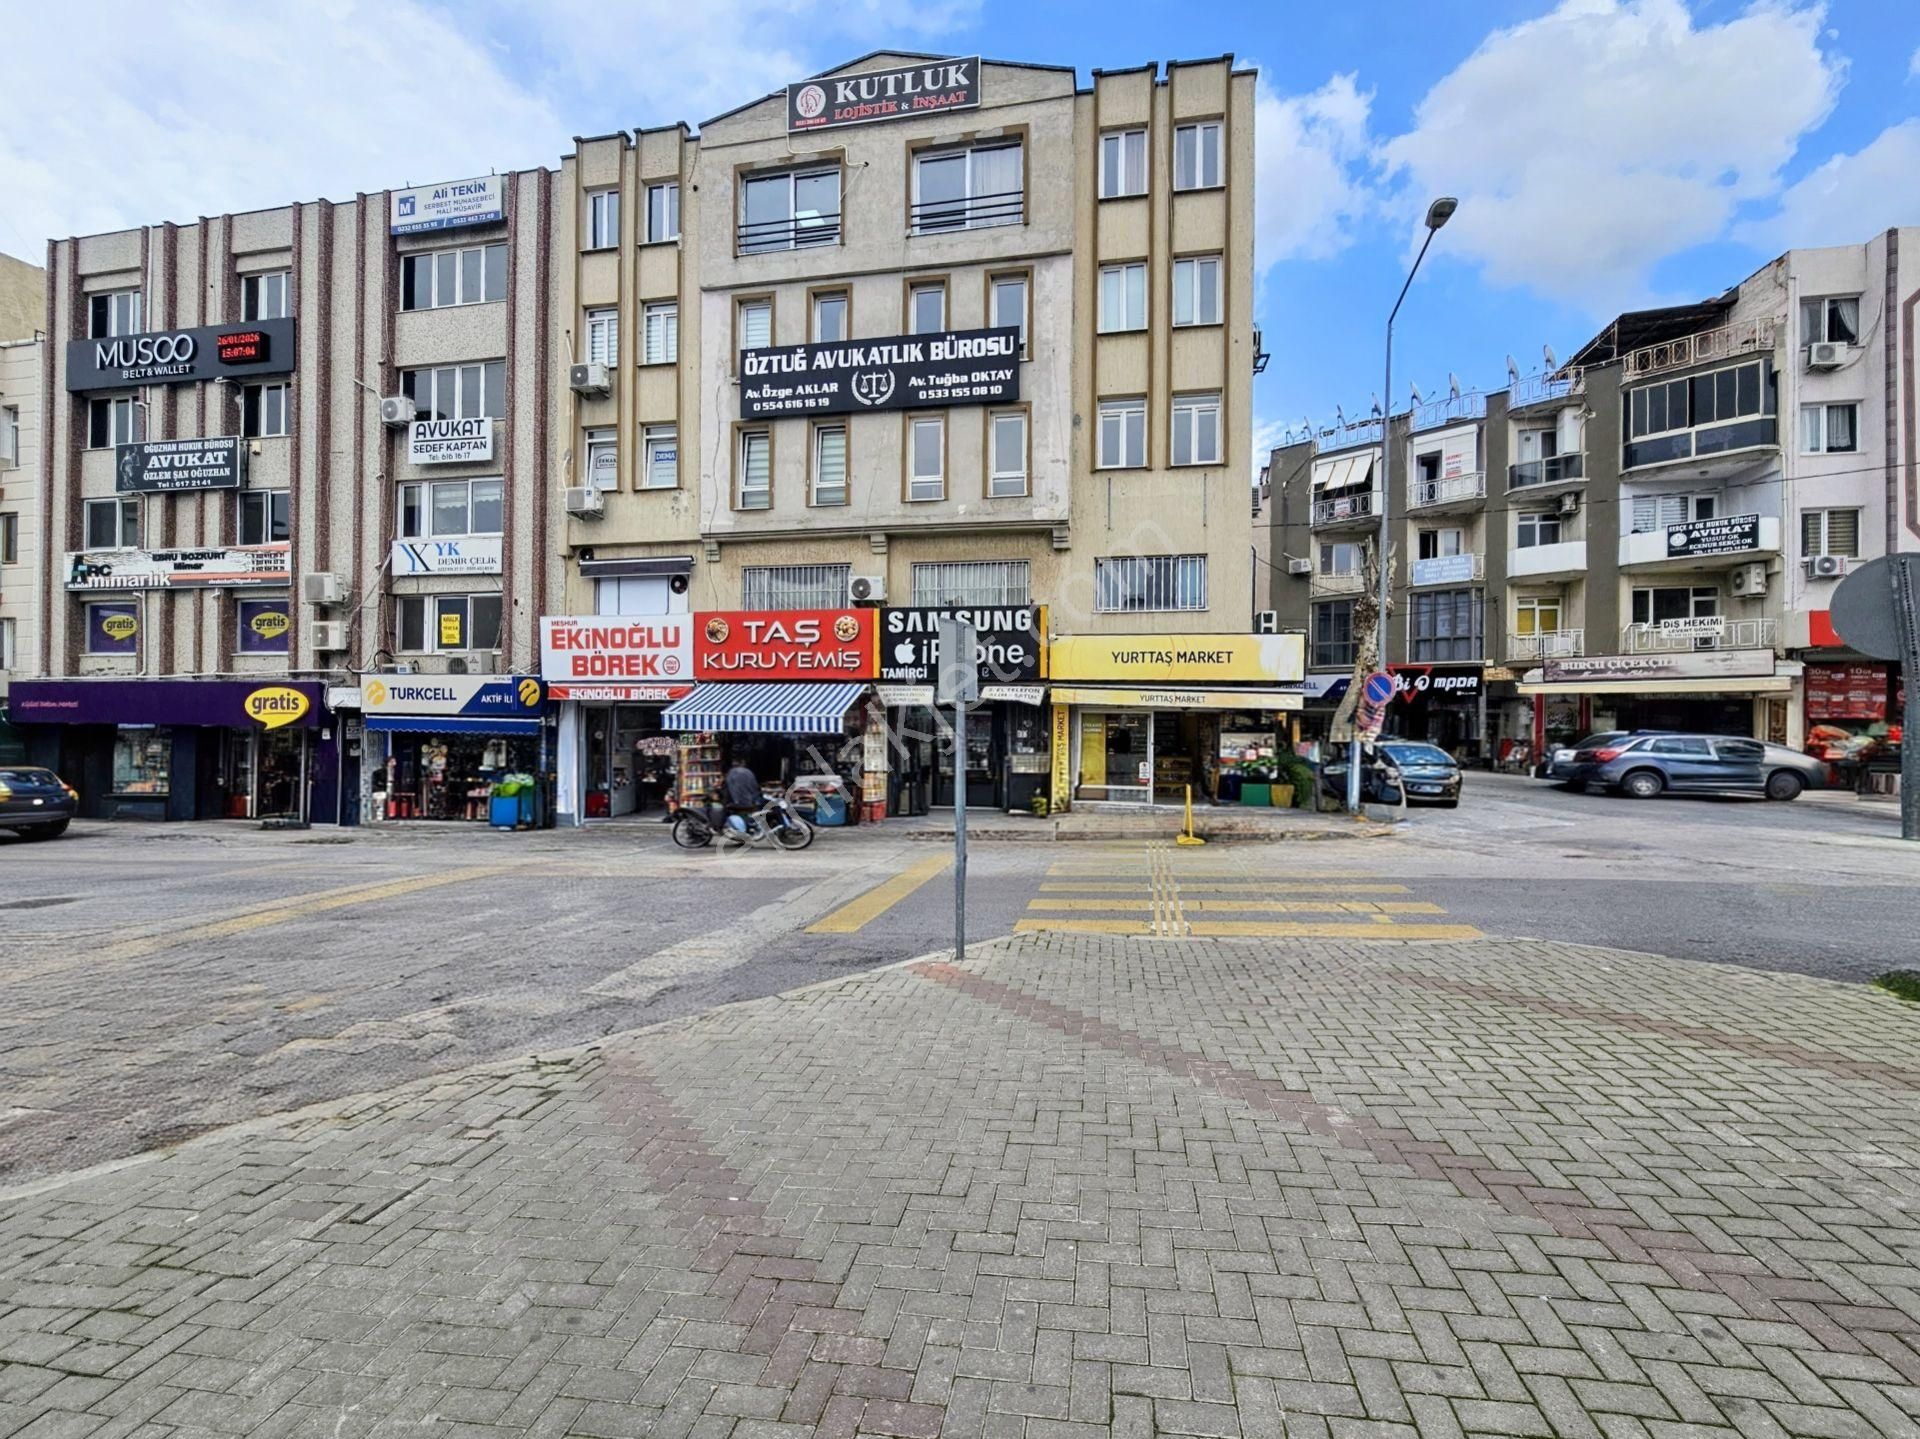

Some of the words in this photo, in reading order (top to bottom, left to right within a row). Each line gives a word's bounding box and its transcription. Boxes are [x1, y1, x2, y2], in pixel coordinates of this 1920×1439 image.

[834, 63, 970, 104] KUTLUK
[834, 99, 898, 120] LOJİSTİK
[901, 101, 910, 110] &
[912, 91, 967, 109] İNŞAAT
[432, 189, 448, 200] Ali
[451, 180, 487, 196] TEKİN
[424, 200, 452, 211] SERBEST
[453, 193, 495, 206] MUHASEBECİ
[744, 348, 807, 376] ÖZTUĞ
[812, 342, 923, 371] AVUKATLIK
[930, 335, 1014, 361] BÜROSU
[908, 375, 926, 387] Av.
[928, 371, 969, 387] Tuğba
[971, 368, 1014, 383] OKTAY
[745, 388, 761, 400] Av.
[762, 384, 793, 401] Özge
[795, 382, 839, 395] AKLAR
[919, 390, 926, 399] 0
[927, 388, 949, 399] 533
[951, 387, 971, 397] 155
[989, 385, 1003, 394] 10
[753, 402, 761, 411] 0
[762, 401, 784, 411] 554
[818, 397, 830, 408] 19
[416, 419, 485, 439] AVUKAT
[144, 444, 177, 453] OĞUZHAN
[178, 442, 203, 451] HUKUK
[204, 439, 234, 449] BÜROSU
[413, 443, 444, 454] SEDEF
[446, 441, 487, 451] KAPTAN
[147, 451, 228, 469] AVUKAT
[143, 470, 171, 481] ÖZLEM
[173, 470, 189, 481] ŞAN
[191, 467, 231, 479] OĞUZHAN
[1690, 524, 1753, 538] AVUKAT
[435, 542, 460, 556] YK
[152, 553, 178, 562] EBRU
[180, 551, 227, 561] BOZKURT
[438, 557, 467, 565] DEMİR
[469, 555, 497, 566] ÇELİK
[173, 562, 204, 571] Mimar
[106, 617, 134, 631] gratis
[255, 615, 286, 630] gratis
[743, 620, 820, 647] TAŞ
[572, 650, 660, 676] BÖREK
[703, 648, 861, 672] KURUYEMİŞ
[1112, 651, 1173, 667] YURTTAŞ
[1177, 651, 1233, 664] MARKET
[1560, 660, 1605, 670] BURCU
[881, 665, 928, 679] TAMİRCİ
[389, 687, 457, 700] TURKCELL
[481, 693, 503, 704] AKTİF
[569, 687, 626, 699] EKİNOĞLU
[630, 686, 670, 700] BÖREK
[1139, 694, 1173, 704] YURTTAŞ
[1174, 695, 1206, 704] MARKET
[252, 692, 300, 714] gratis
[1057, 711, 1065, 742] MARKET
